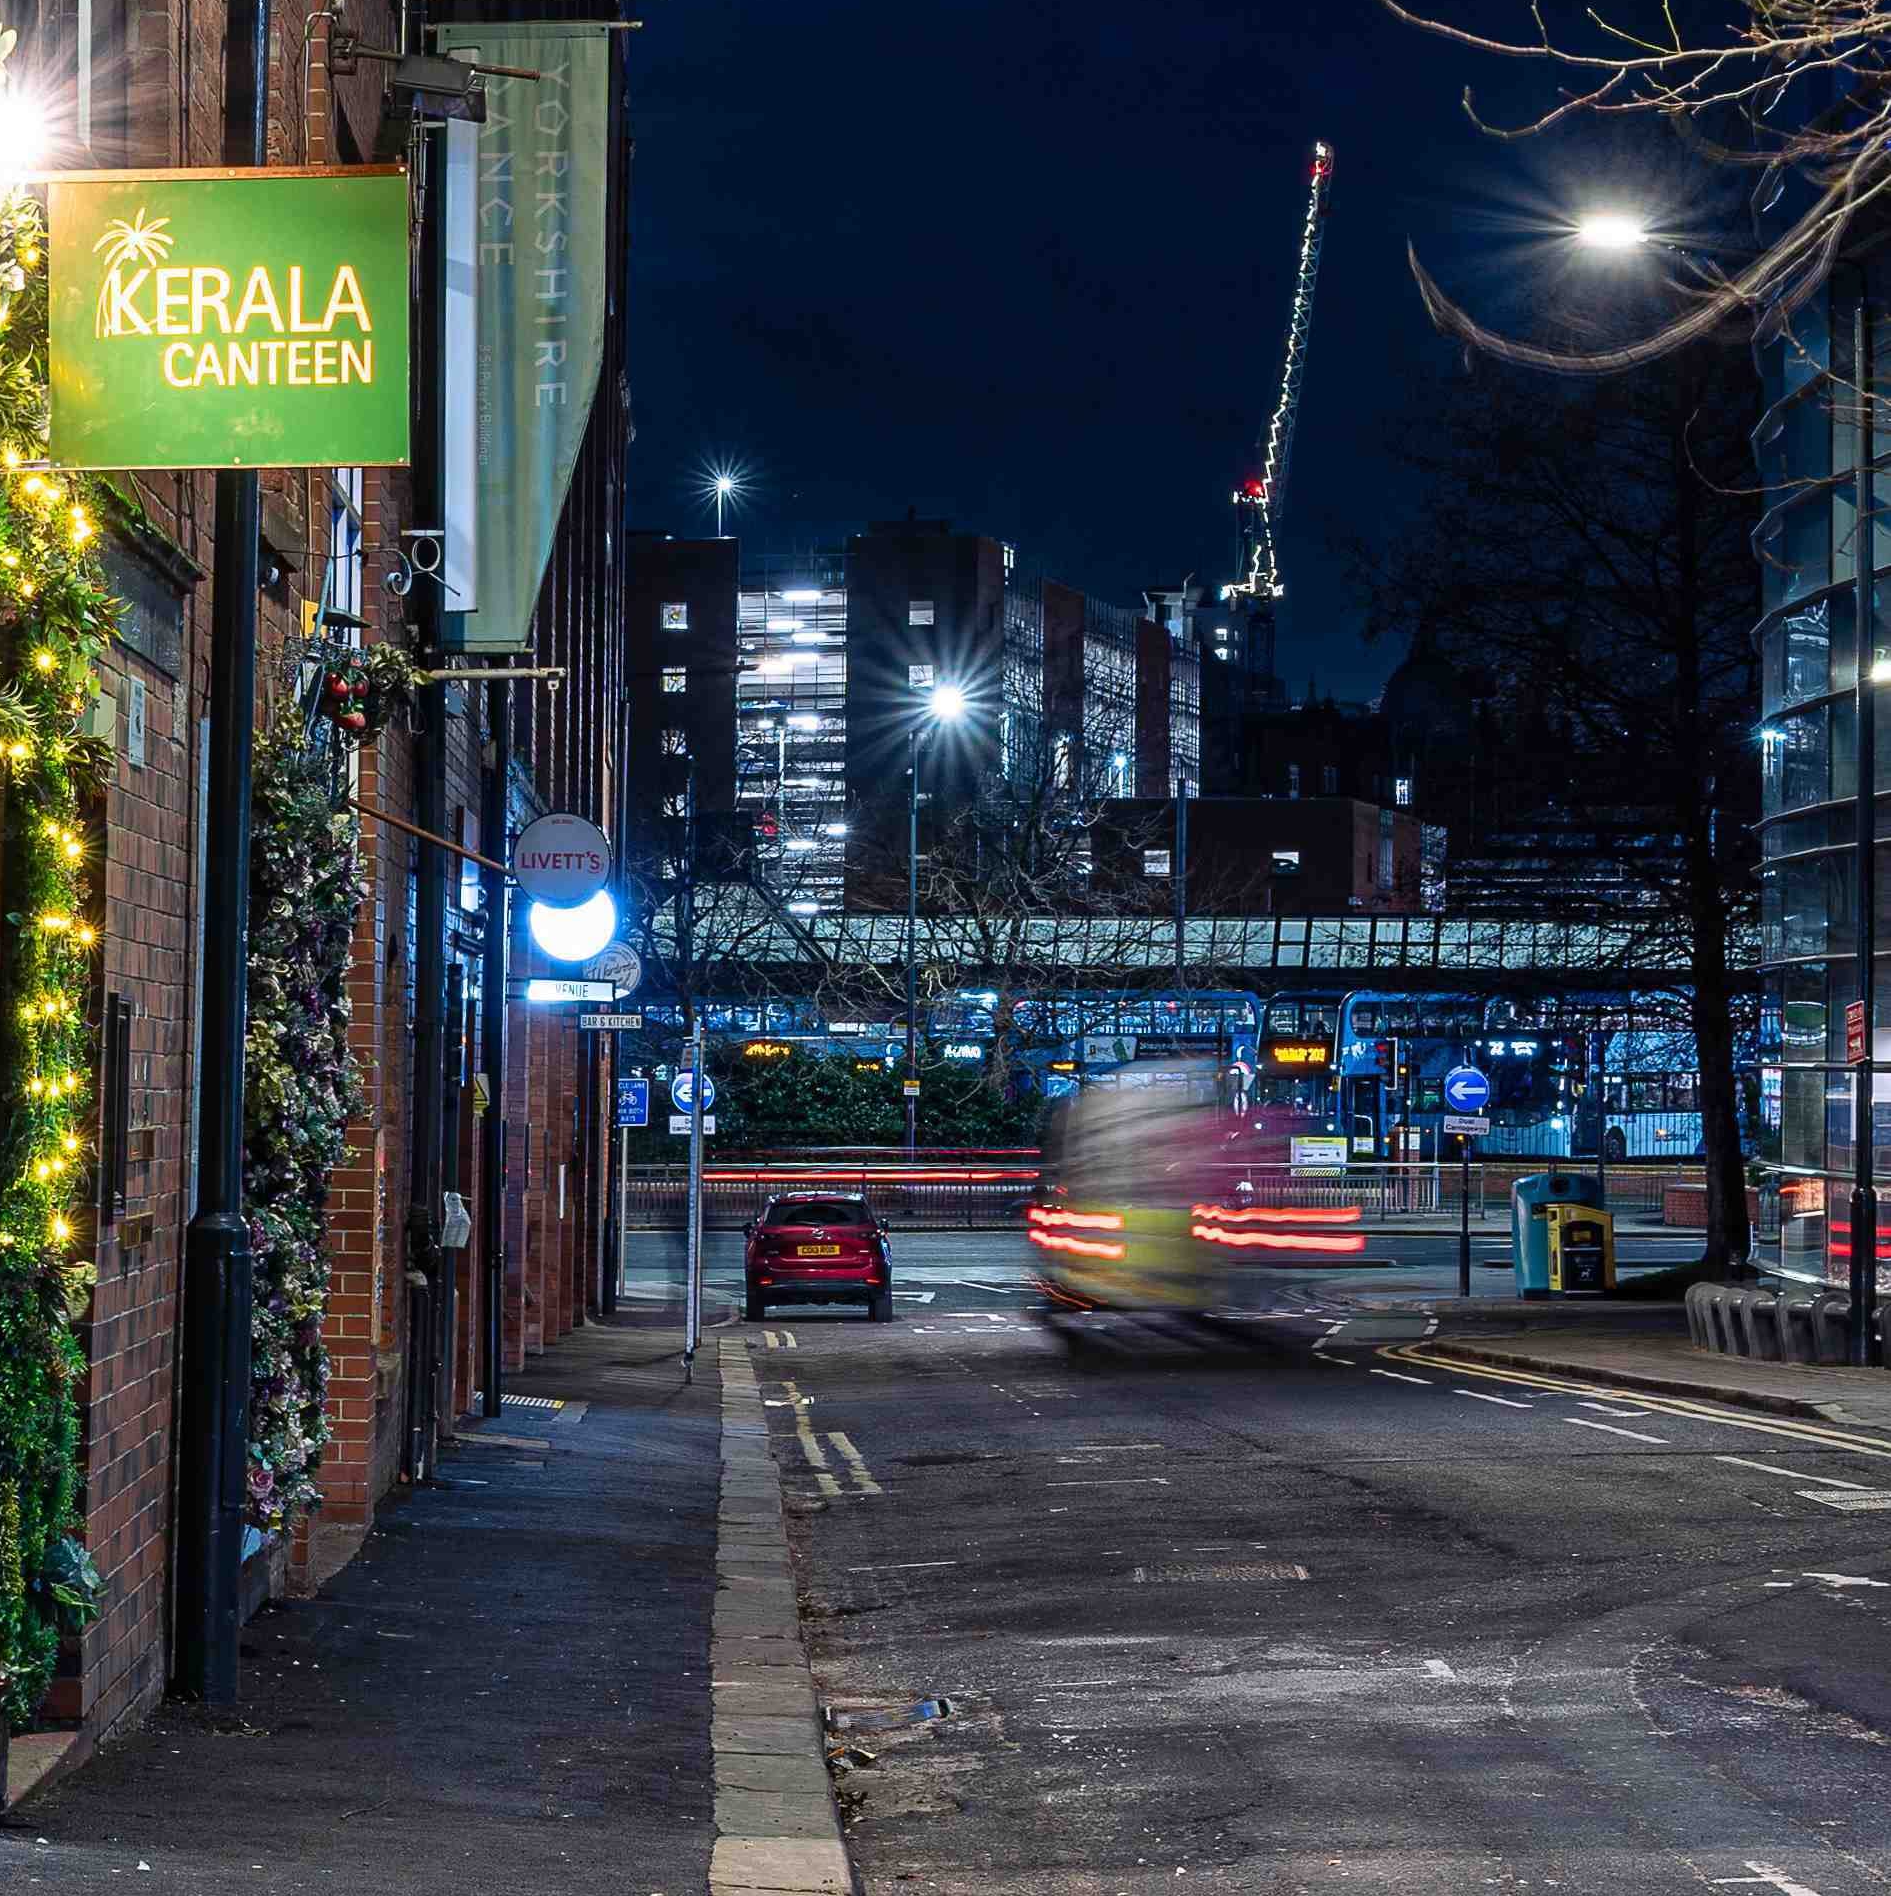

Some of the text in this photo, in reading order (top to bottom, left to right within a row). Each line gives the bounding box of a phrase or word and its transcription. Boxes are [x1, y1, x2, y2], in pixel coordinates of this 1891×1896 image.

[534, 62, 570, 407] YORKSHIRE
[109, 265, 373, 336] KERALA
[163, 340, 373, 387] CANTEEN
[521, 851, 601, 872] LIVETT'S
[555, 983, 589, 998] VENUE
[582, 1016, 598, 1027] BAR
[608, 1016, 641, 1027] KITCHEN
